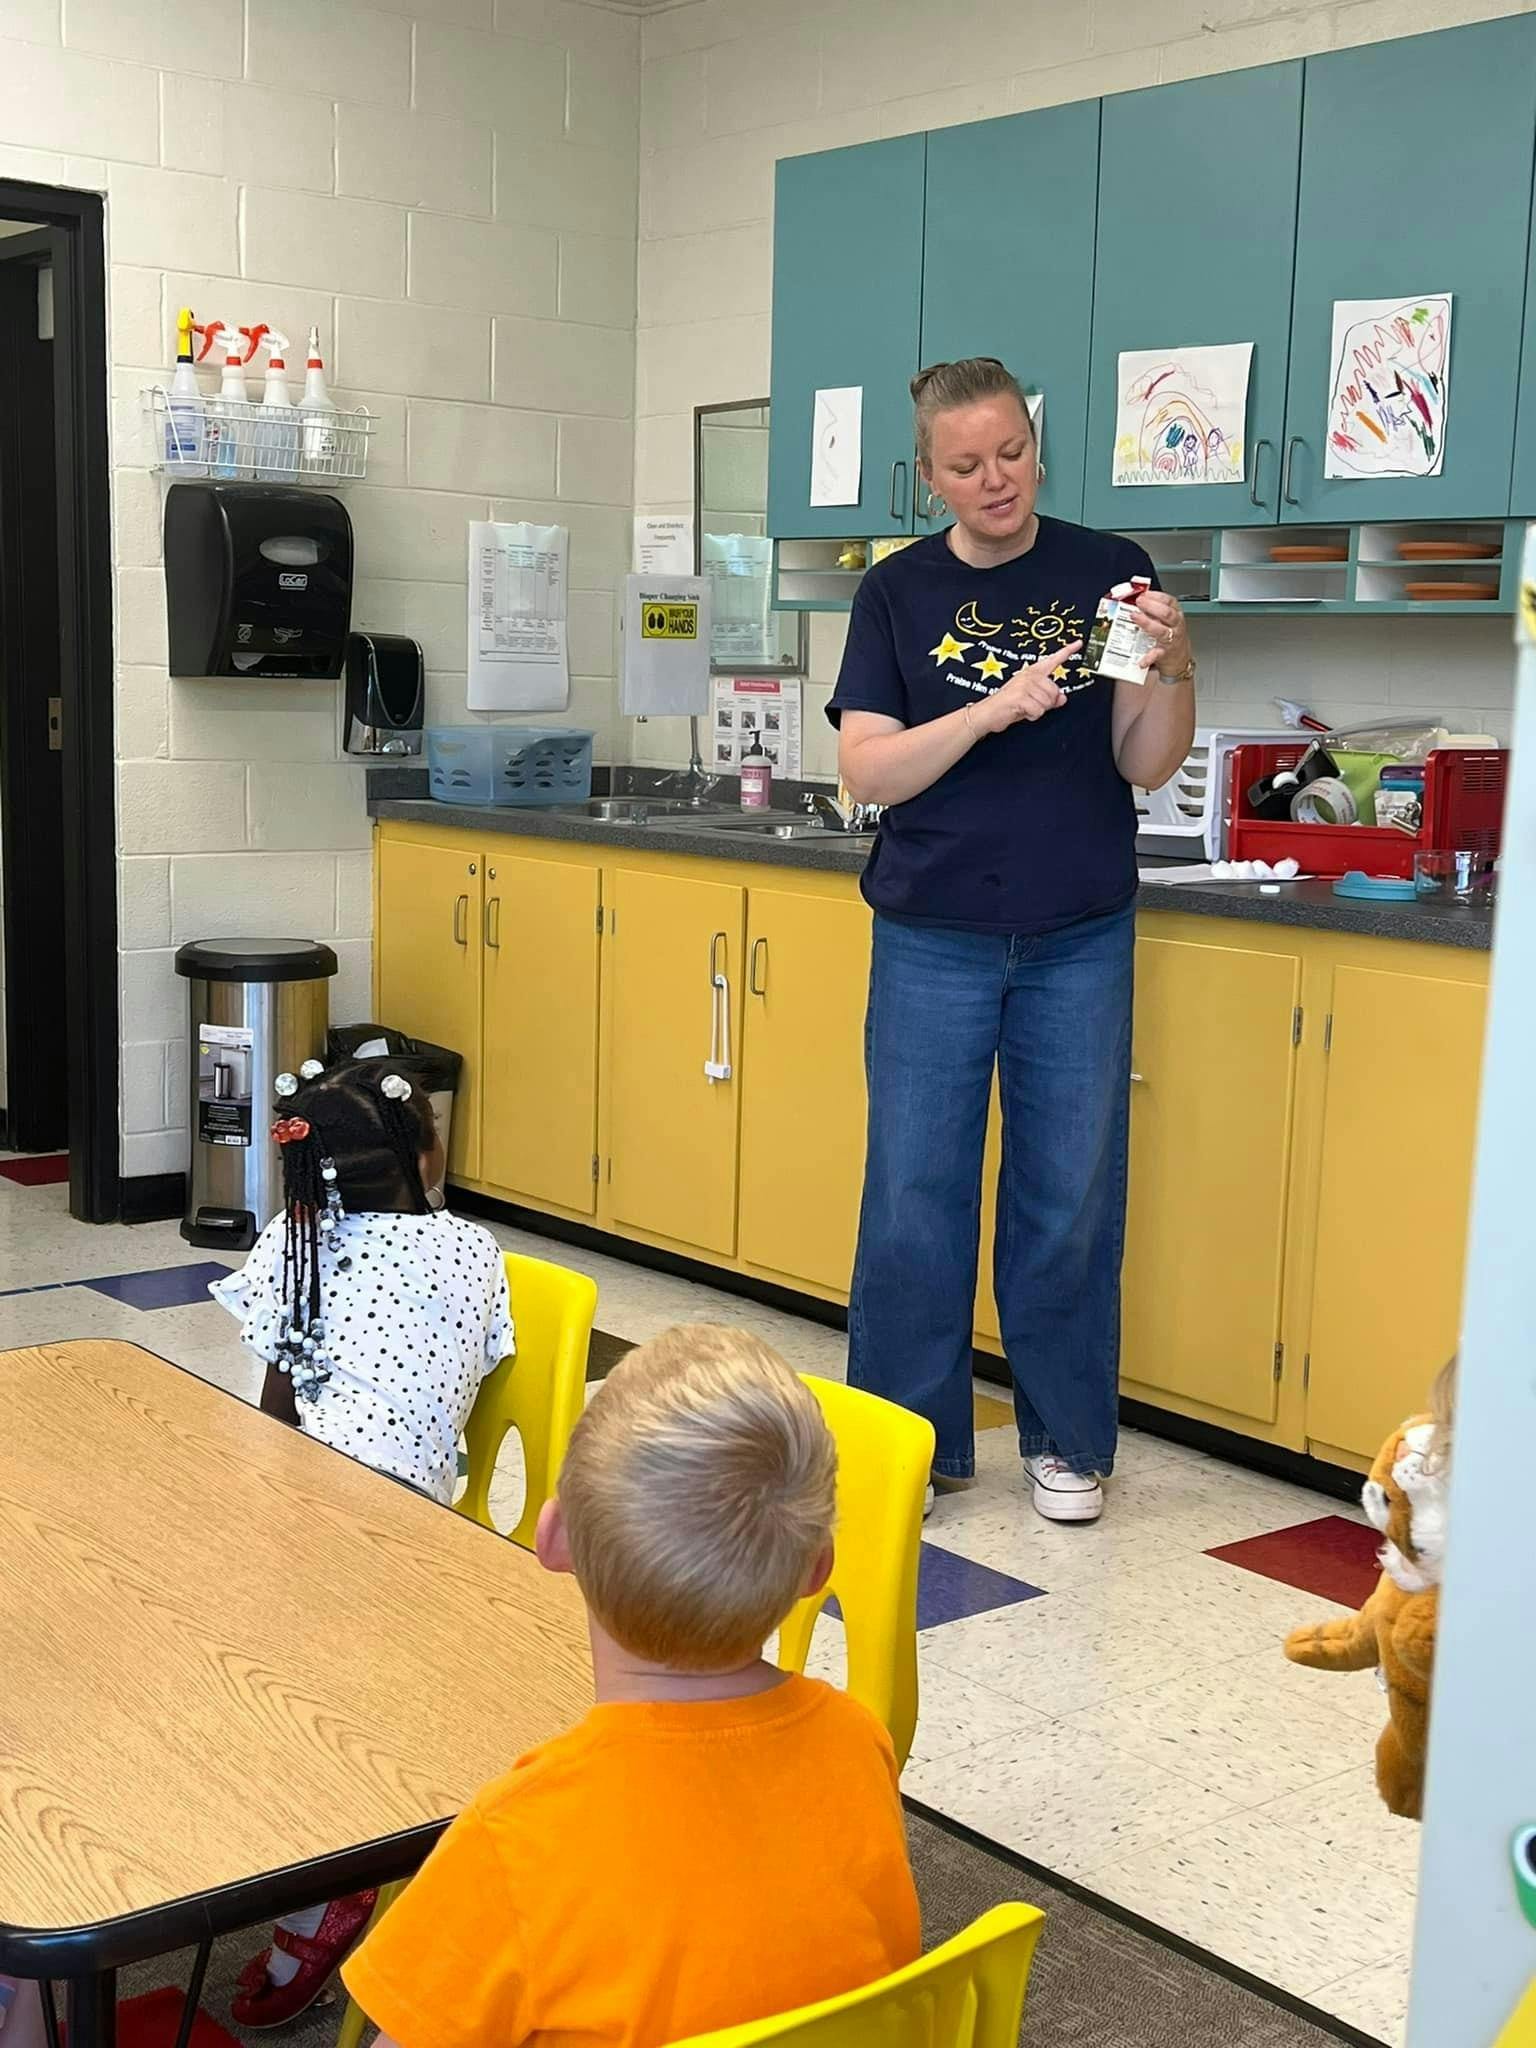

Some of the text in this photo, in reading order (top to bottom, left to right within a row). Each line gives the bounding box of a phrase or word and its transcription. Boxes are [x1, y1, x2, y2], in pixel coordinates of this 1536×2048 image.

[639, 592, 659, 601] Diaper
[660, 592, 686, 602] Changing
[681, 608, 694, 618] YOUR
[669, 619, 694, 634] HANDS
[1020, 653, 1036, 661] sun
[946, 672, 971, 688] Praise
[971, 681, 988, 694] Him
